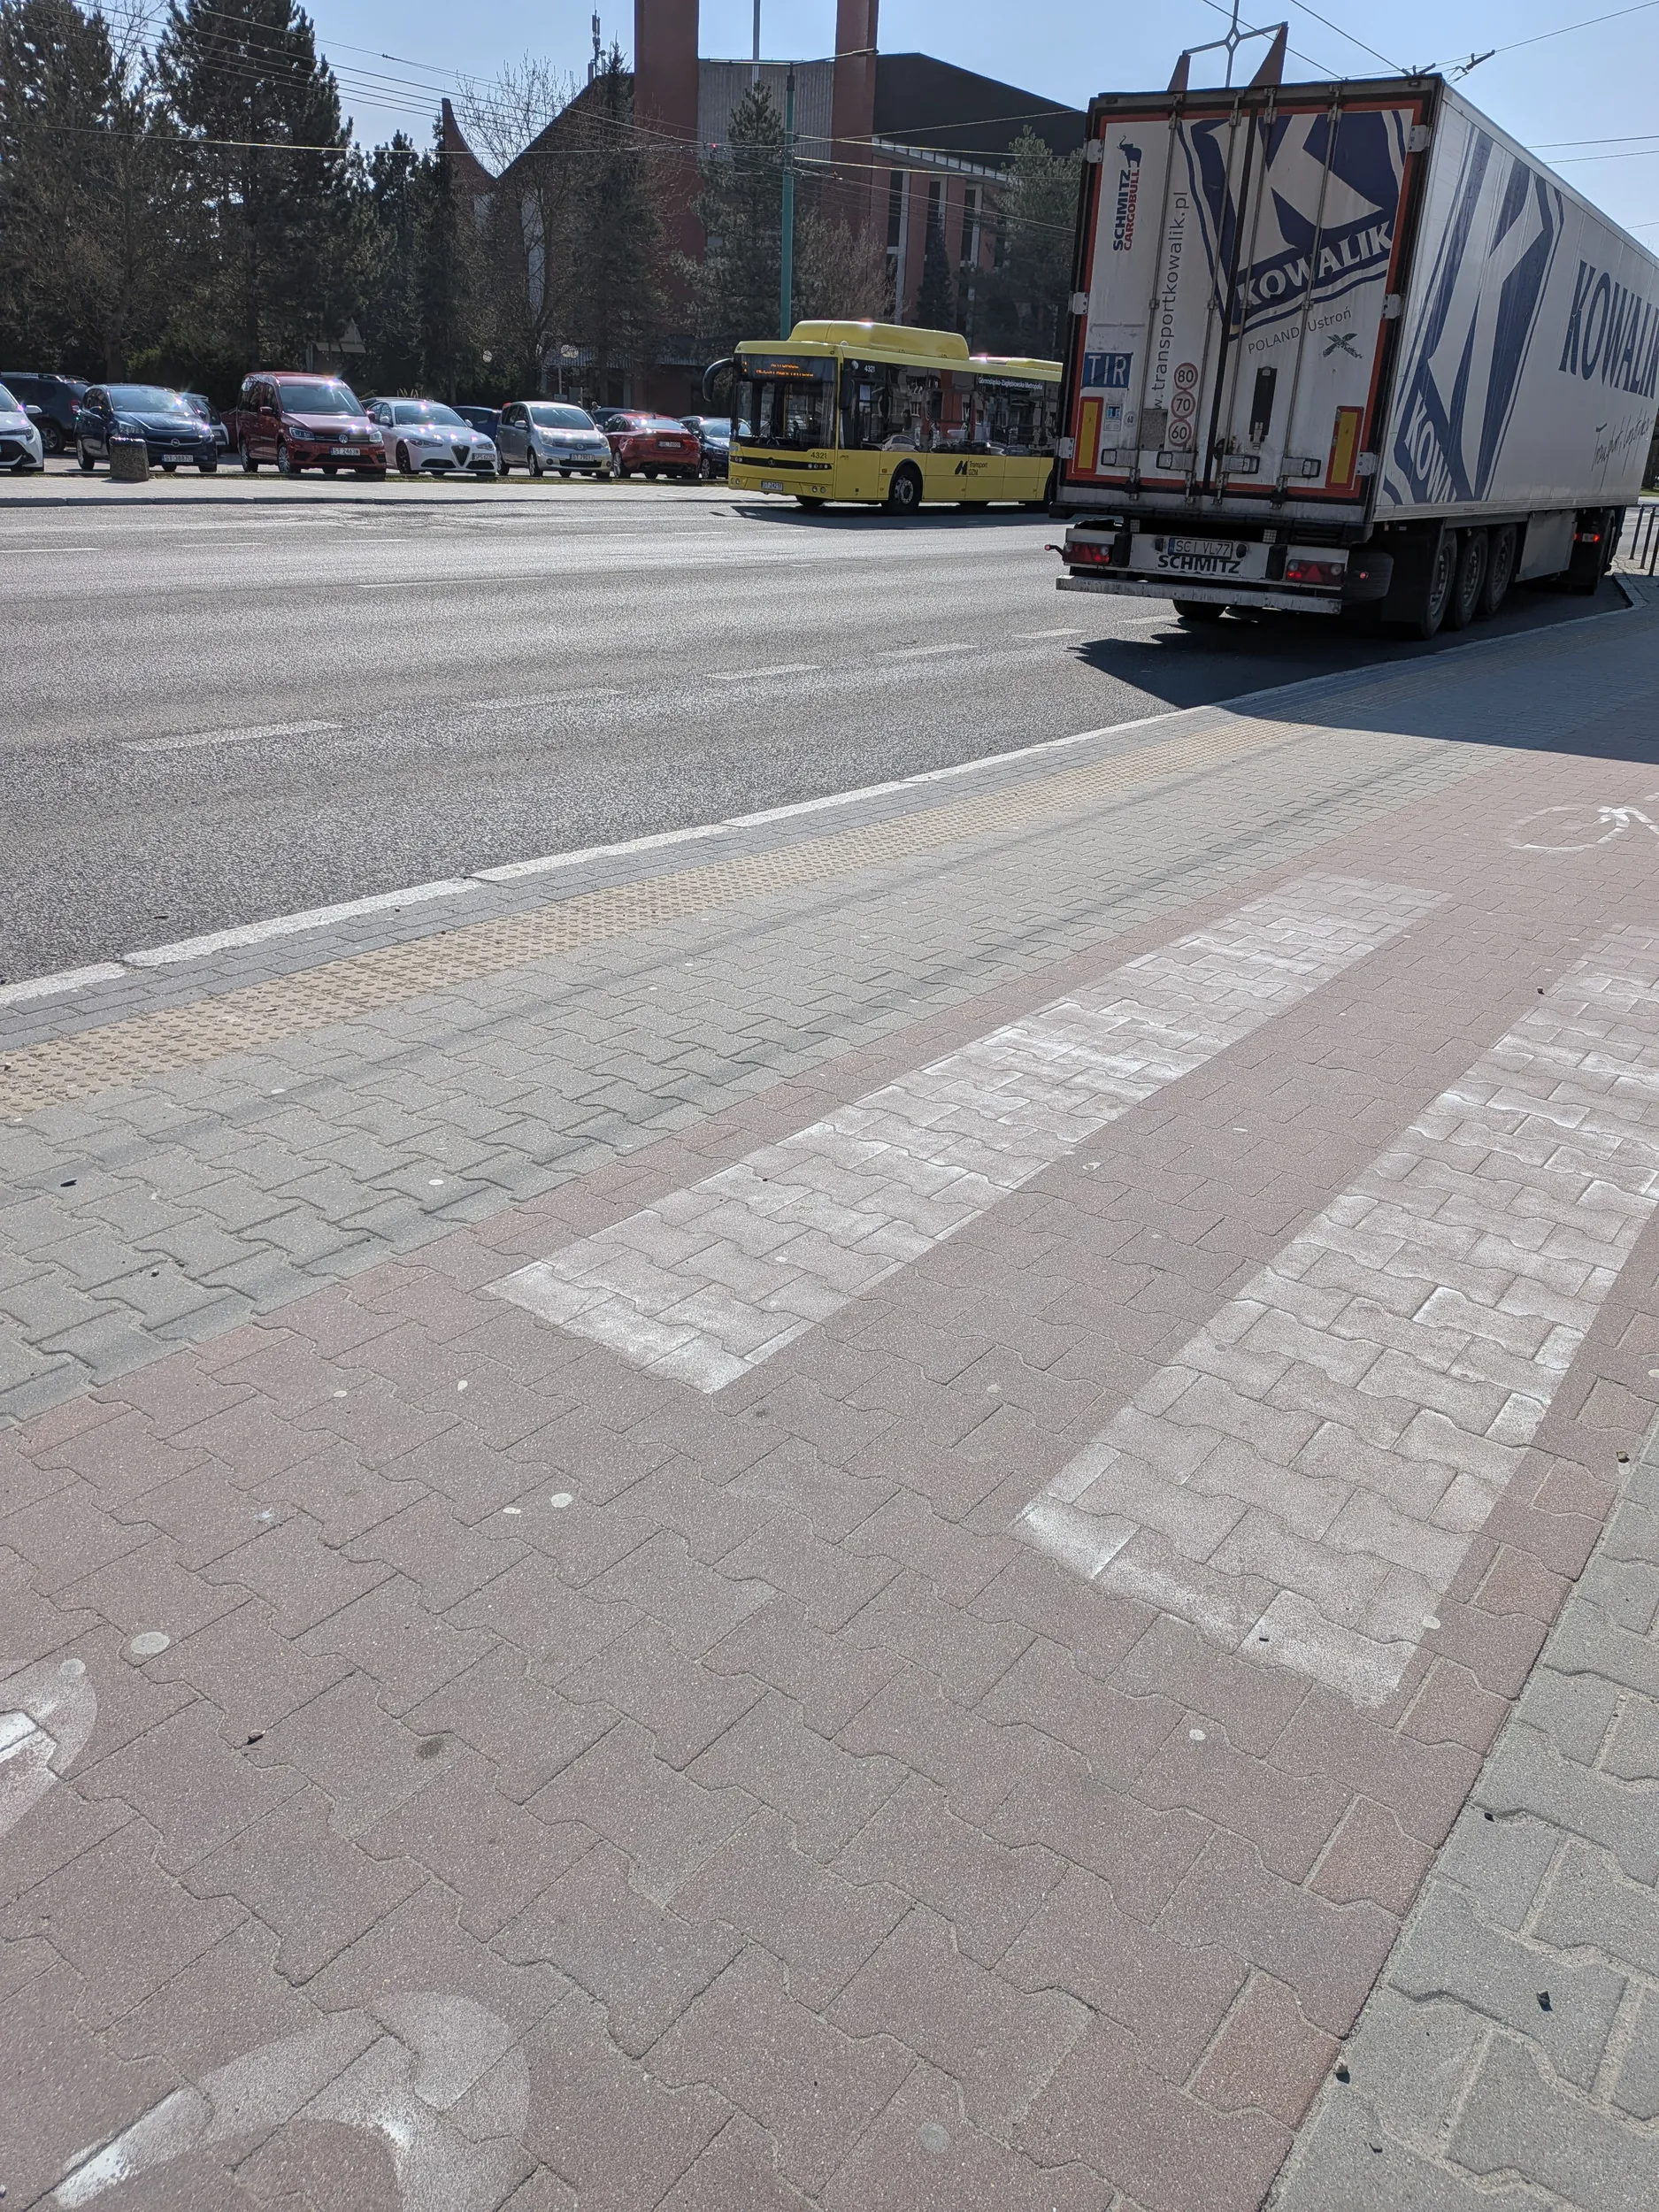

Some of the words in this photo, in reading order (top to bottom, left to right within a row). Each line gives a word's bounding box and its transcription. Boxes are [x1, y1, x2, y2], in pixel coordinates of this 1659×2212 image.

[1113, 169, 1131, 251] SCHMITZ
[1124, 168, 1141, 251] CARGOBULL
[1235, 219, 1394, 306] KOWALIK
[1248, 326, 1300, 355] POLAND
[1307, 306, 1352, 332] Ustroń
[864, 365, 876, 373] 4321
[1087, 355, 1127, 385] TIR
[1177, 369, 1194, 383] 80
[1176, 398, 1191, 411] 70
[1171, 425, 1187, 440] 60
[810, 451, 827, 460] 4321
[1203, 541, 1231, 556] VL77
[1156, 554, 1241, 574] SCHMITZ
